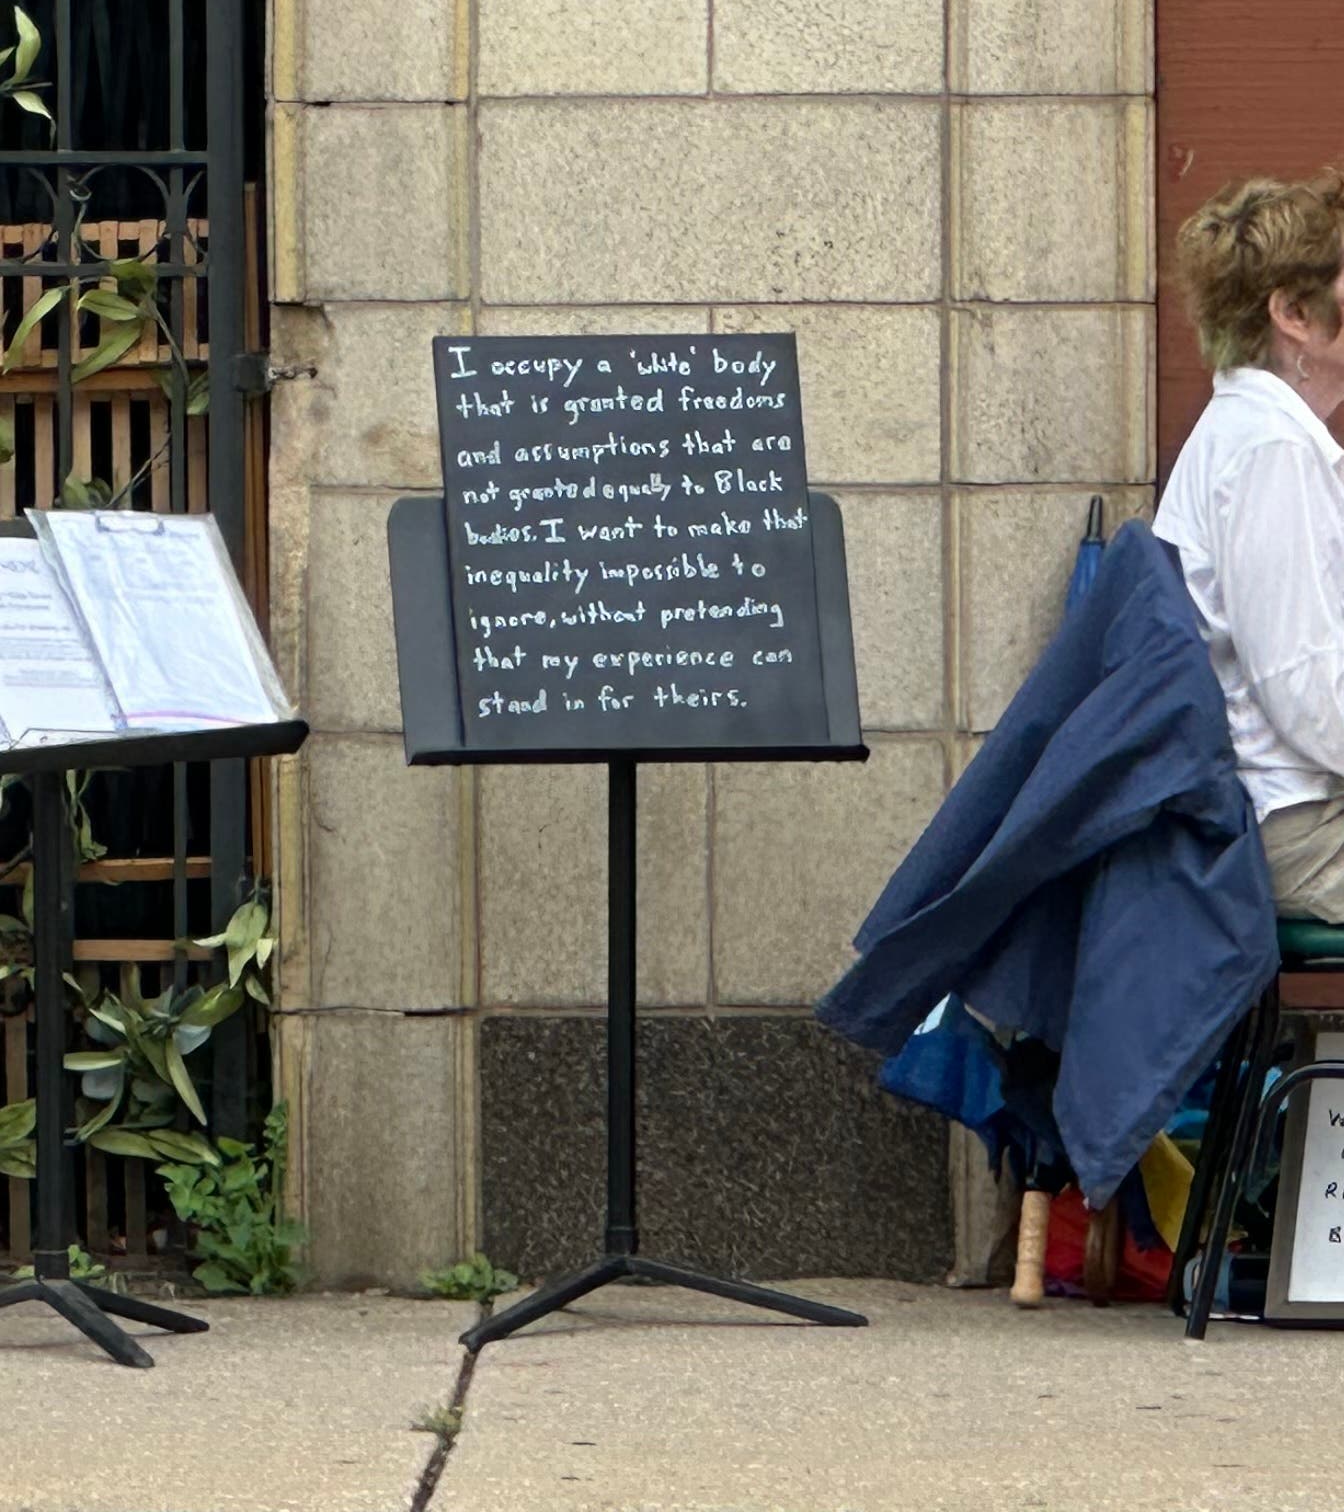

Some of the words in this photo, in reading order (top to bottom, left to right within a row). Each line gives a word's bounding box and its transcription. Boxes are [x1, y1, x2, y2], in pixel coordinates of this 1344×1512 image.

[448, 347, 477, 378] I
[491, 358, 583, 387] occupy
[597, 360, 612, 374] a
[712, 348, 776, 386] body
[456, 389, 515, 419] that
[531, 395, 549, 414] is
[564, 385, 664, 425] granted
[679, 386, 786, 412] freedoms
[457, 440, 501, 468] and
[514, 431, 670, 464] assumptions
[682, 429, 736, 456] that
[752, 435, 791, 451] are
[462, 481, 500, 504] not
[508, 476, 596, 512] granted
[681, 474, 705, 495] to
[714, 468, 783, 494] Black
[539, 518, 566, 543] I
[577, 515, 643, 541] want
[654, 514, 678, 538] to
[688, 511, 751, 538] make
[763, 507, 808, 530] that
[464, 558, 589, 594] inequality
[599, 553, 720, 587] impossible
[732, 553, 766, 578] to
[561, 600, 646, 625] without
[661, 597, 784, 630] pretending
[473, 645, 526, 671] that
[542, 655, 579, 679] my
[592, 645, 734, 676] experience
[752, 648, 793, 666] can
[478, 688, 547, 718] stand
[562, 692, 584, 711] in
[598, 685, 635, 712] for
[653, 682, 748, 708] theirs.
